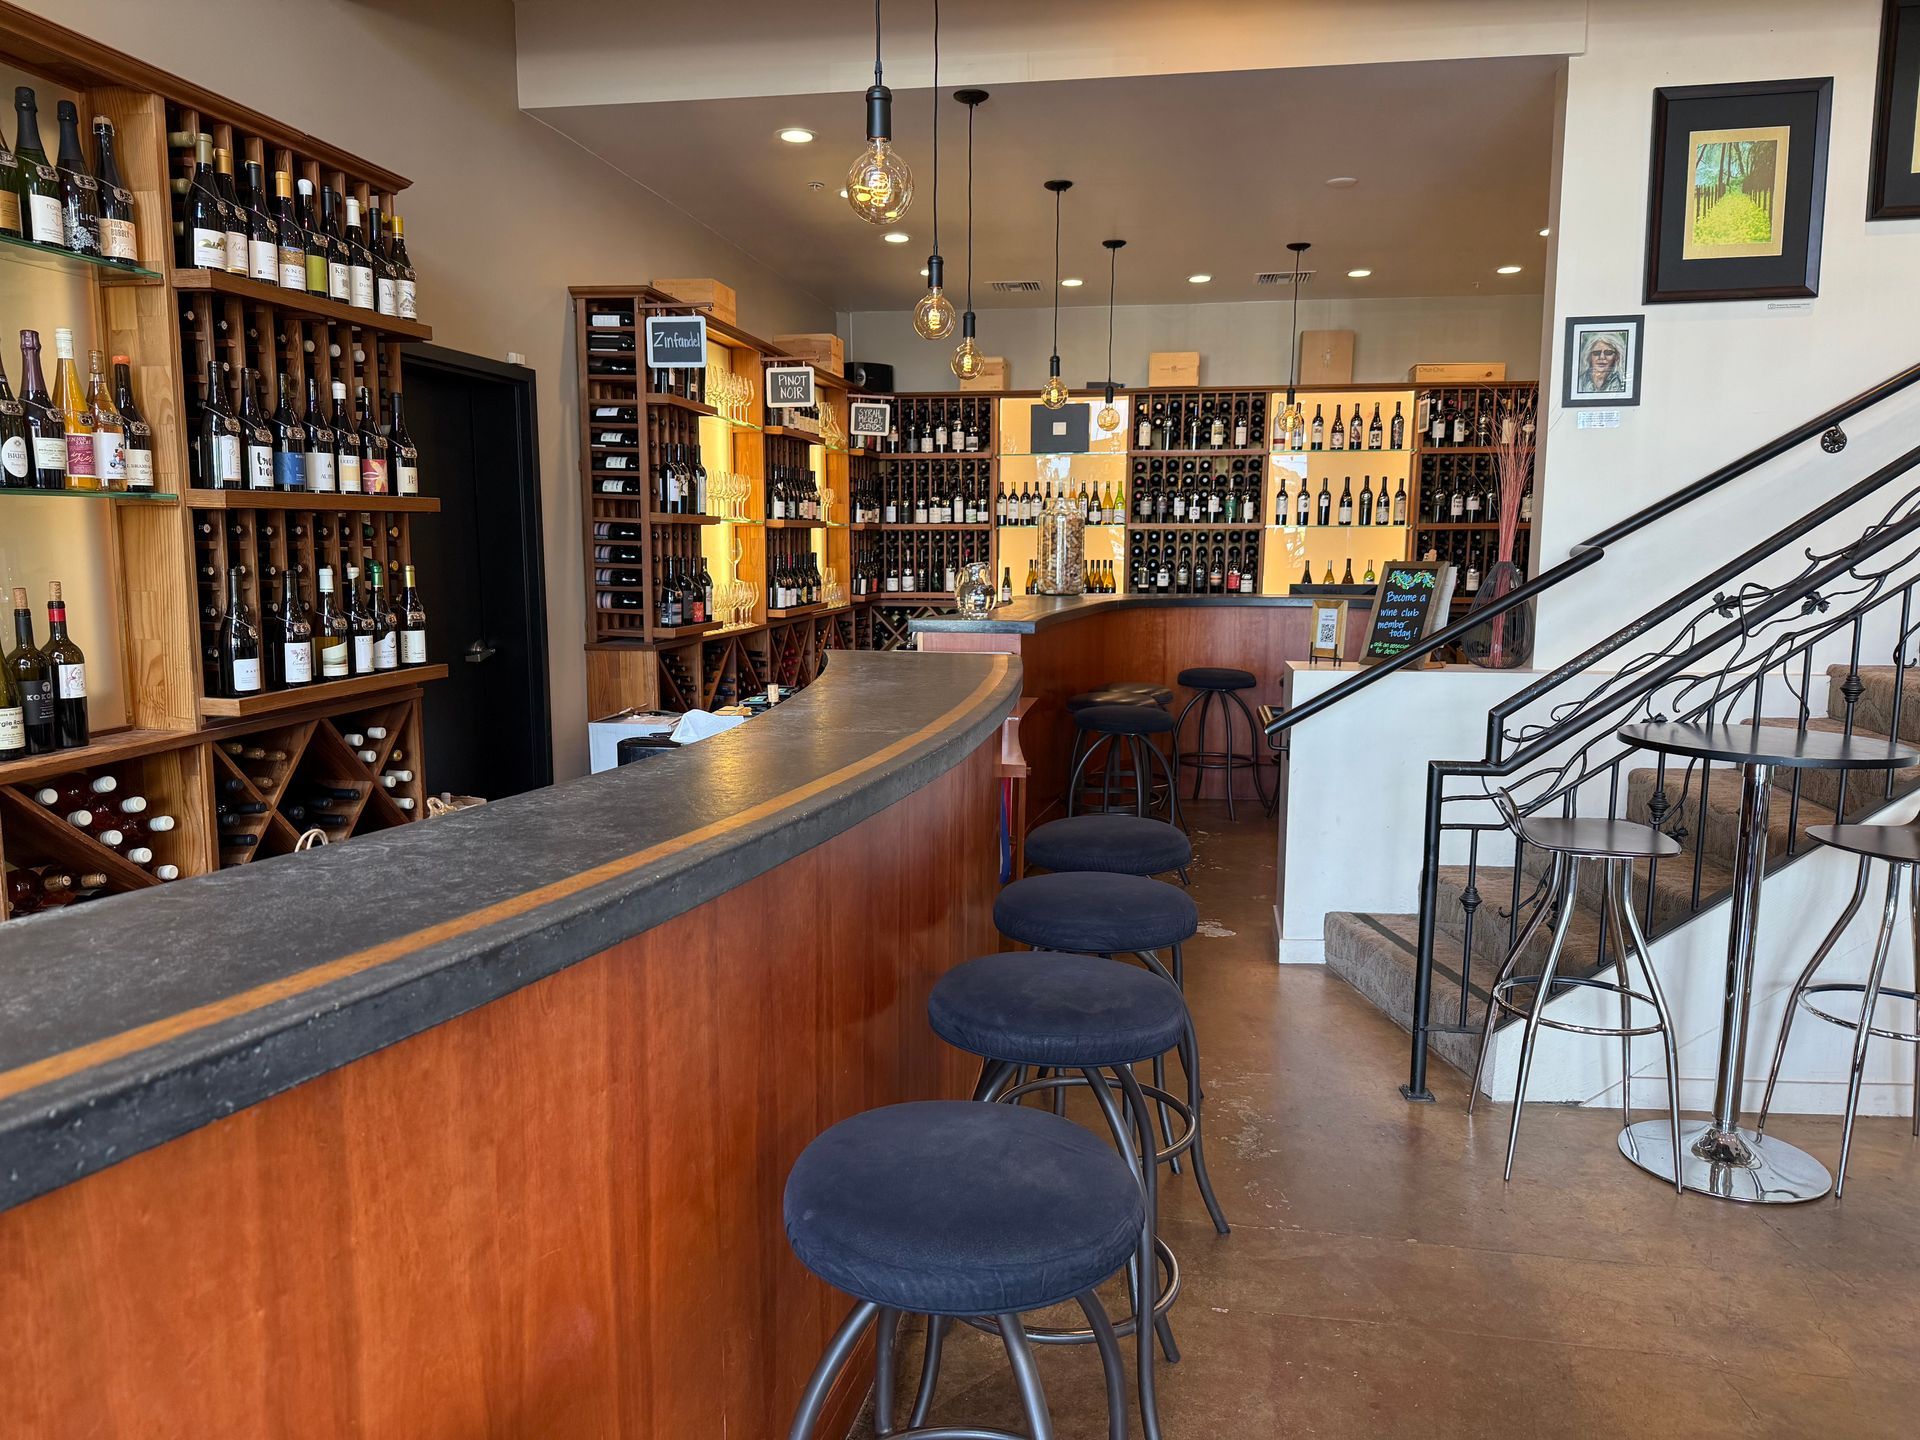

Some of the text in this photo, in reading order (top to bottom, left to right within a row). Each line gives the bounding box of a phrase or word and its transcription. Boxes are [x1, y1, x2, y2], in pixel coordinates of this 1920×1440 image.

[653, 331, 701, 348] Zinfandel
[778, 374, 807, 387] PINOT
[780, 386, 805, 399] NOIR
[1386, 591, 1417, 603] Become
[1380, 608, 1420, 617] wine club
[1377, 620, 1409, 629] member
